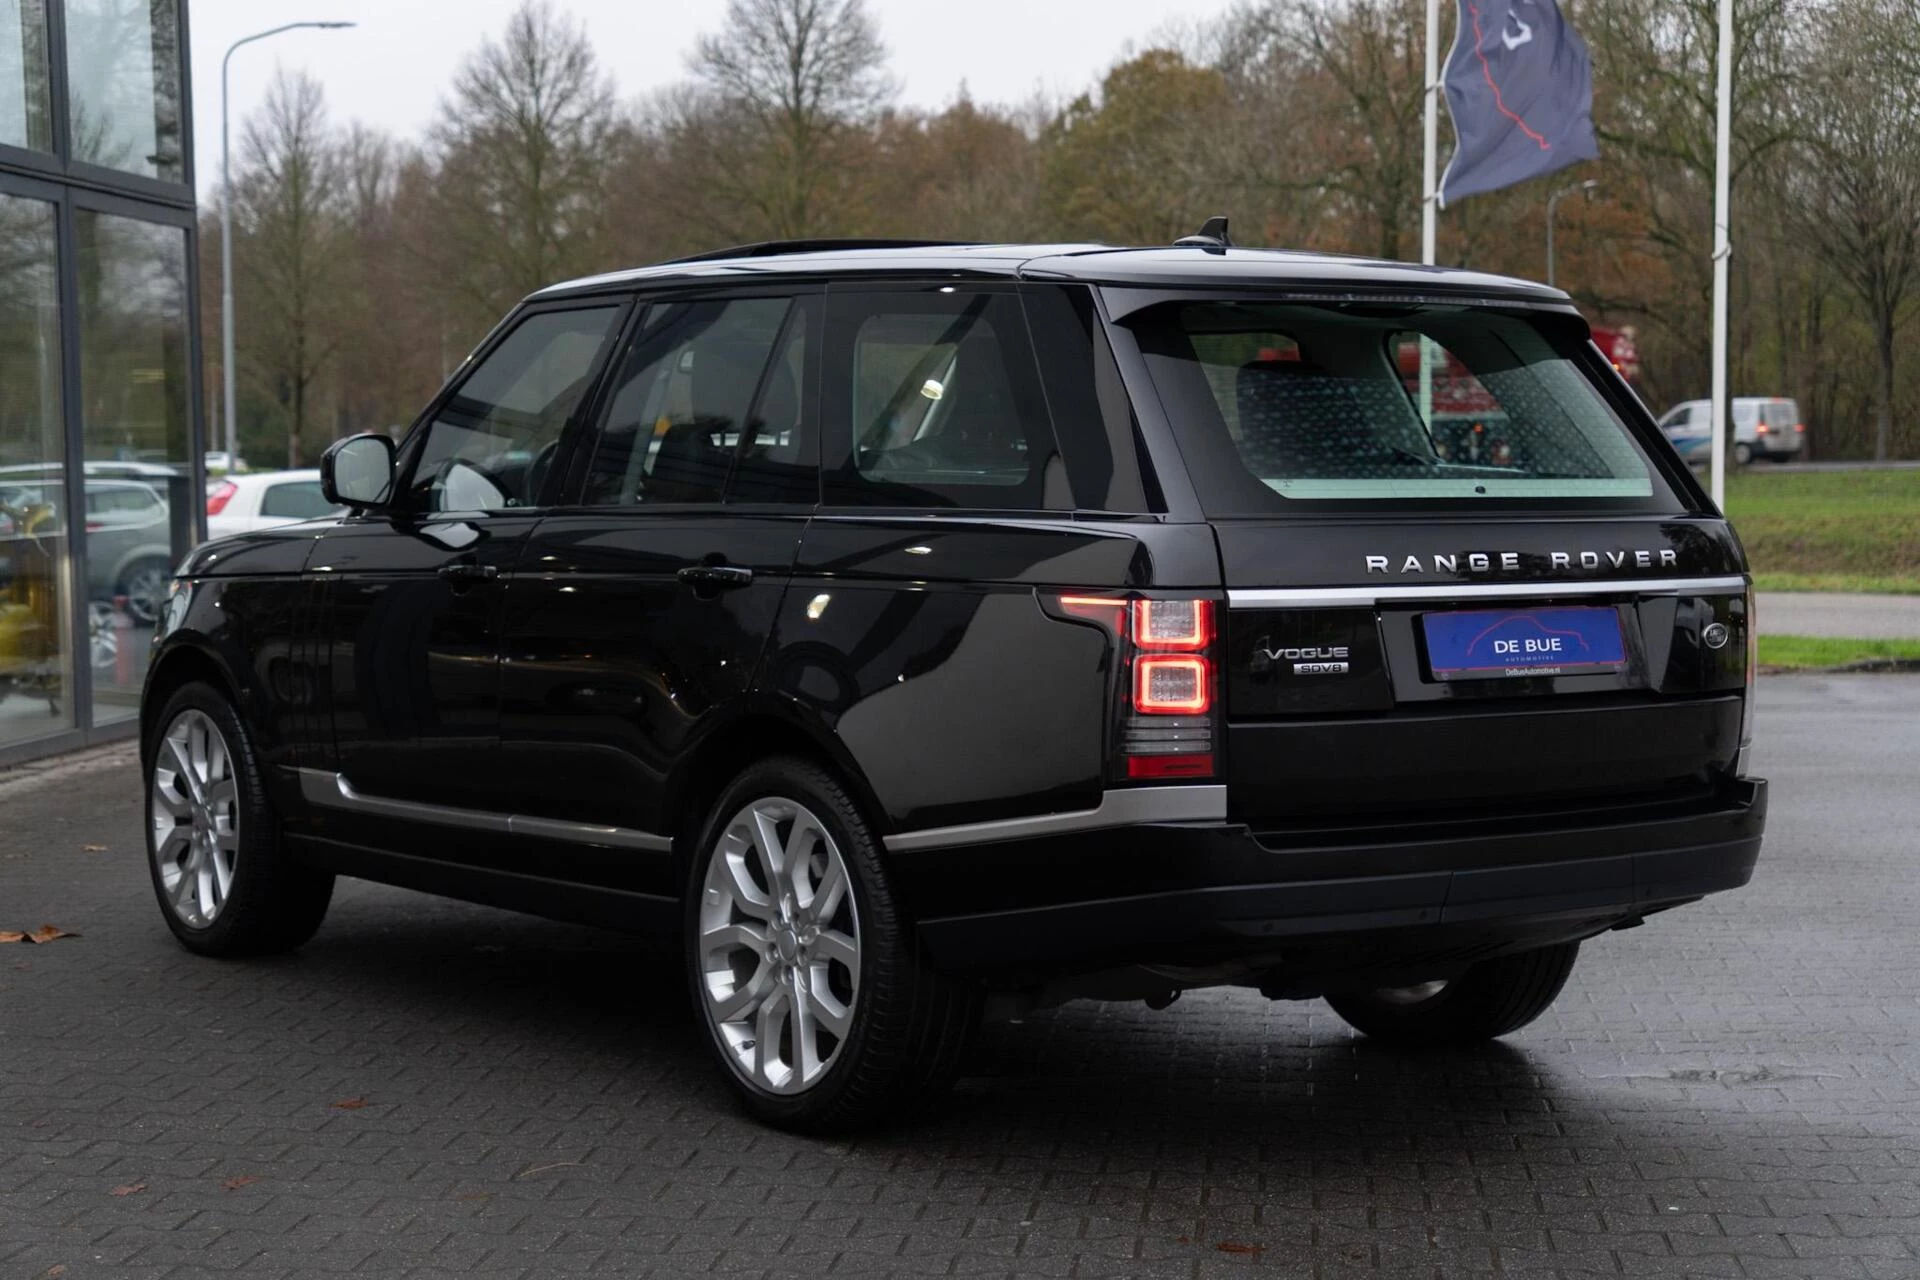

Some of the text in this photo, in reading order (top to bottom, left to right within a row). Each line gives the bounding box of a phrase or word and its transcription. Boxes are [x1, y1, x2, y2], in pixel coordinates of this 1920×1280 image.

[1365, 549, 1678, 574] RANGE ROVER
[1262, 646, 1349, 660] VOGUE
[1494, 638, 1562, 654] DE BUE
[1300, 663, 1342, 673] SDV8
